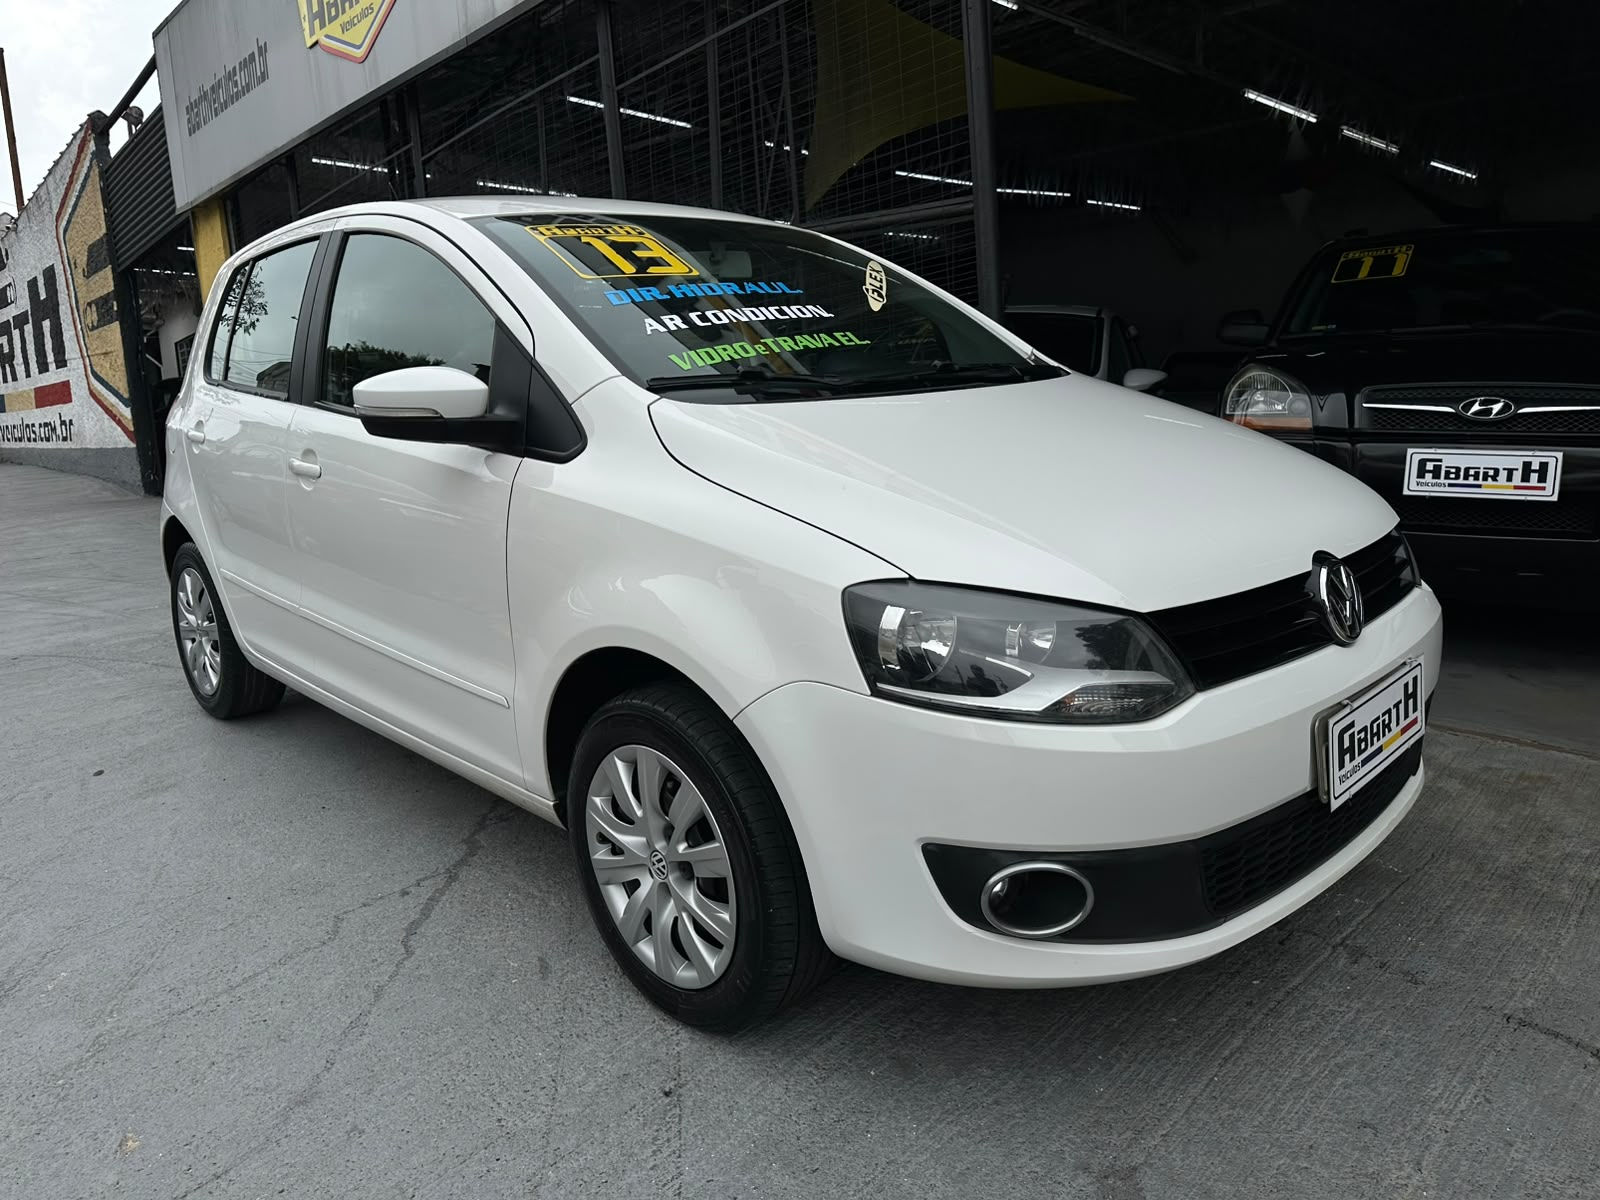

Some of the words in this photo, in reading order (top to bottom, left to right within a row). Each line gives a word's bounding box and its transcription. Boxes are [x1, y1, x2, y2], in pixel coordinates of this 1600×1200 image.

[581, 235, 690, 274] 13
[1357, 254, 1408, 280] 11
[863, 264, 885, 303] FLEX
[643, 313, 689, 335] AR
[690, 304, 835, 328] CONDICION.
[667, 341, 757, 371] VIDRO
[754, 344, 770, 355] e
[760, 333, 842, 354] TRAVA
[1416, 457, 1550, 484] ABARTH
[1338, 674, 1419, 772] ABARTH
